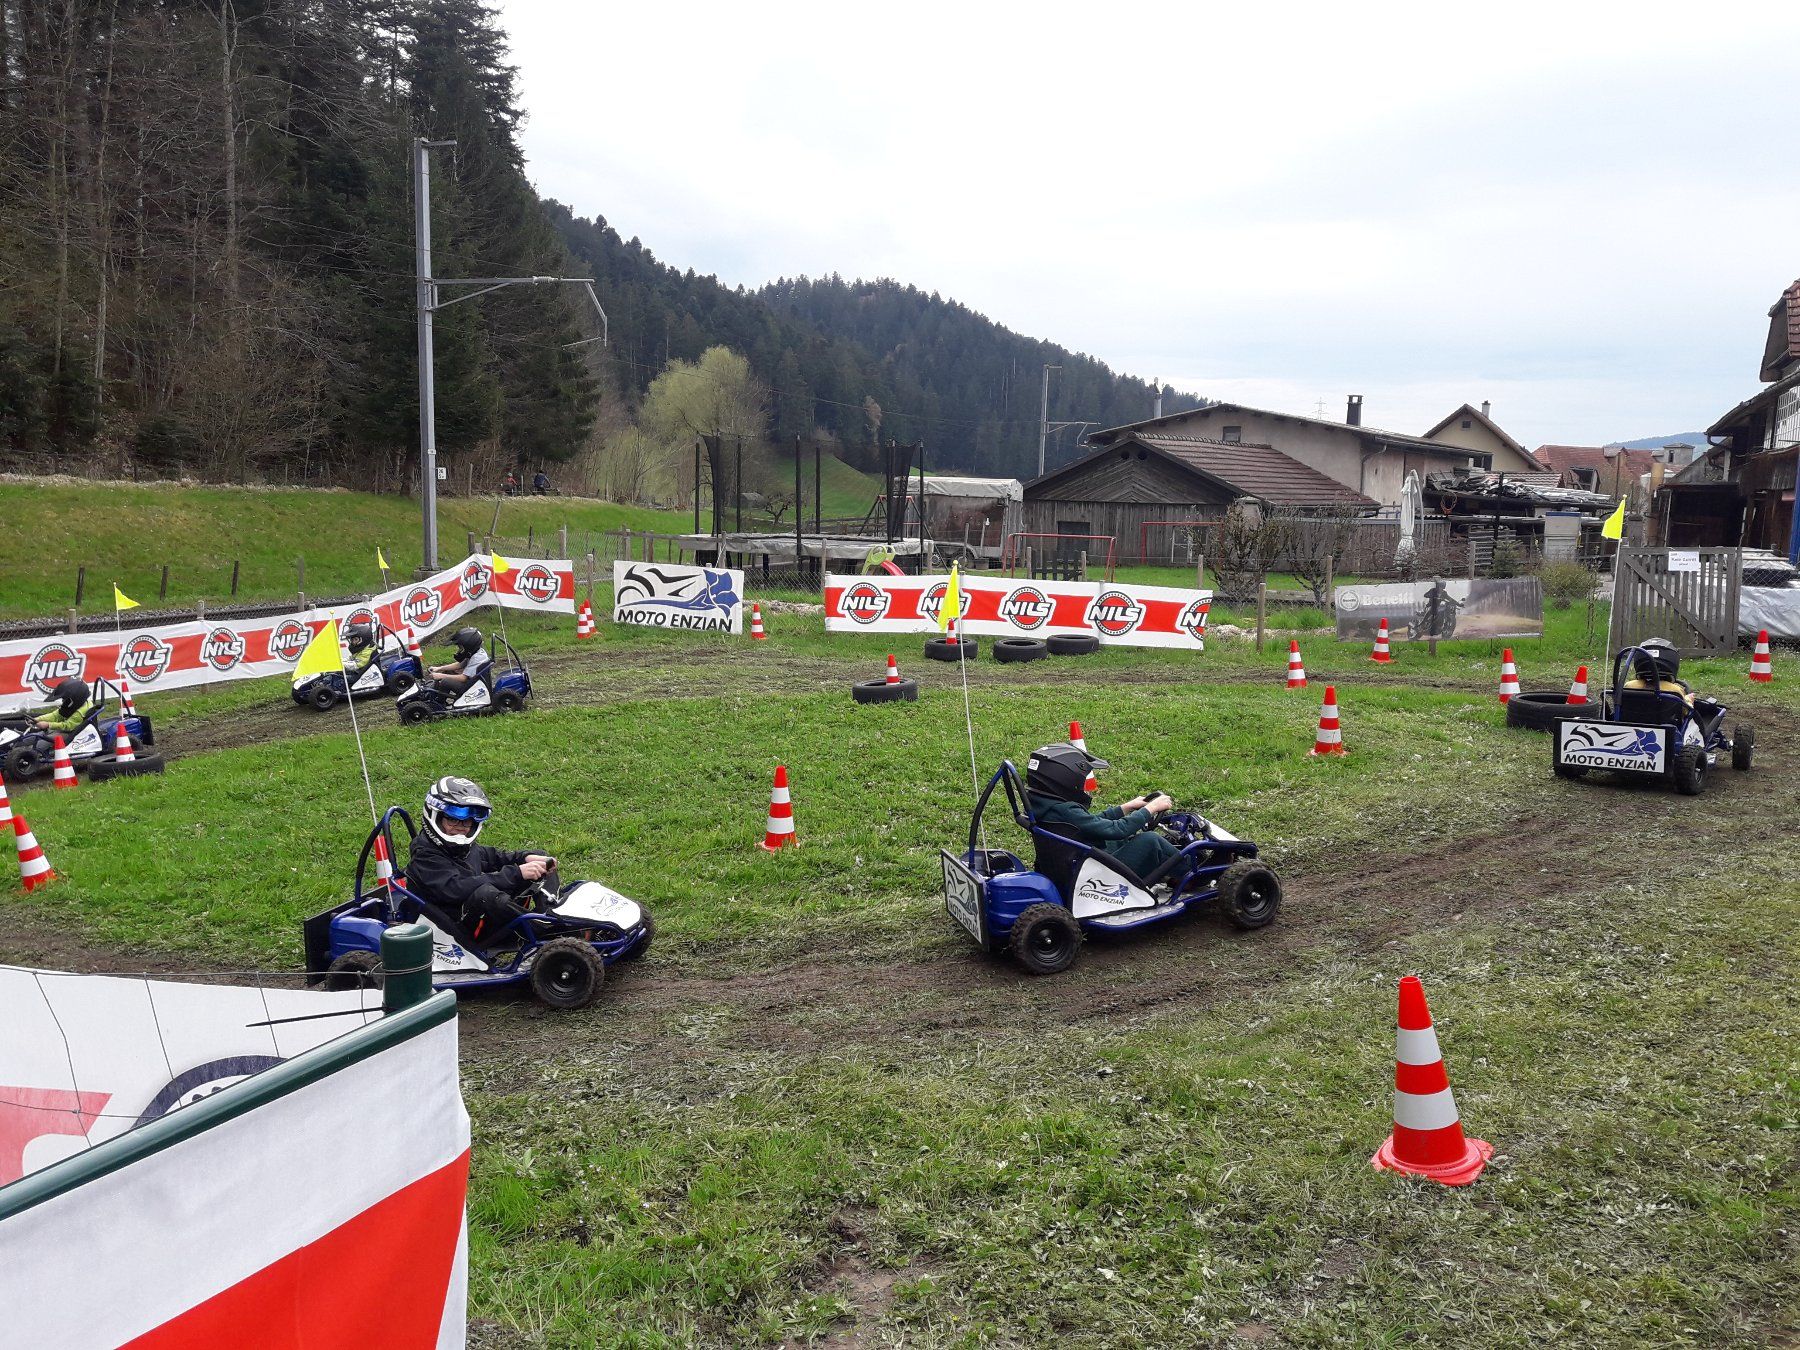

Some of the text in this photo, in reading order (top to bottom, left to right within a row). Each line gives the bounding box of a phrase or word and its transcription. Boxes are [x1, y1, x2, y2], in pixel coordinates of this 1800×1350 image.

[462, 571, 488, 594] NILS
[519, 577, 559, 592] NILS
[403, 594, 439, 620] NILS
[842, 596, 888, 611] NILS
[1003, 600, 1053, 618] NILS
[617, 609, 733, 633] MOTO ENZIAN
[1088, 605, 1143, 623] NILS
[204, 641, 243, 659] NILS
[272, 631, 309, 651] NILS
[121, 648, 168, 669] NILS
[27, 658, 82, 681] NILS
[1564, 754, 1656, 771] MOTO ENZIAN
[1078, 891, 1124, 906] MOTO ENZIAN
[436, 953, 462, 966] ENZIAN
